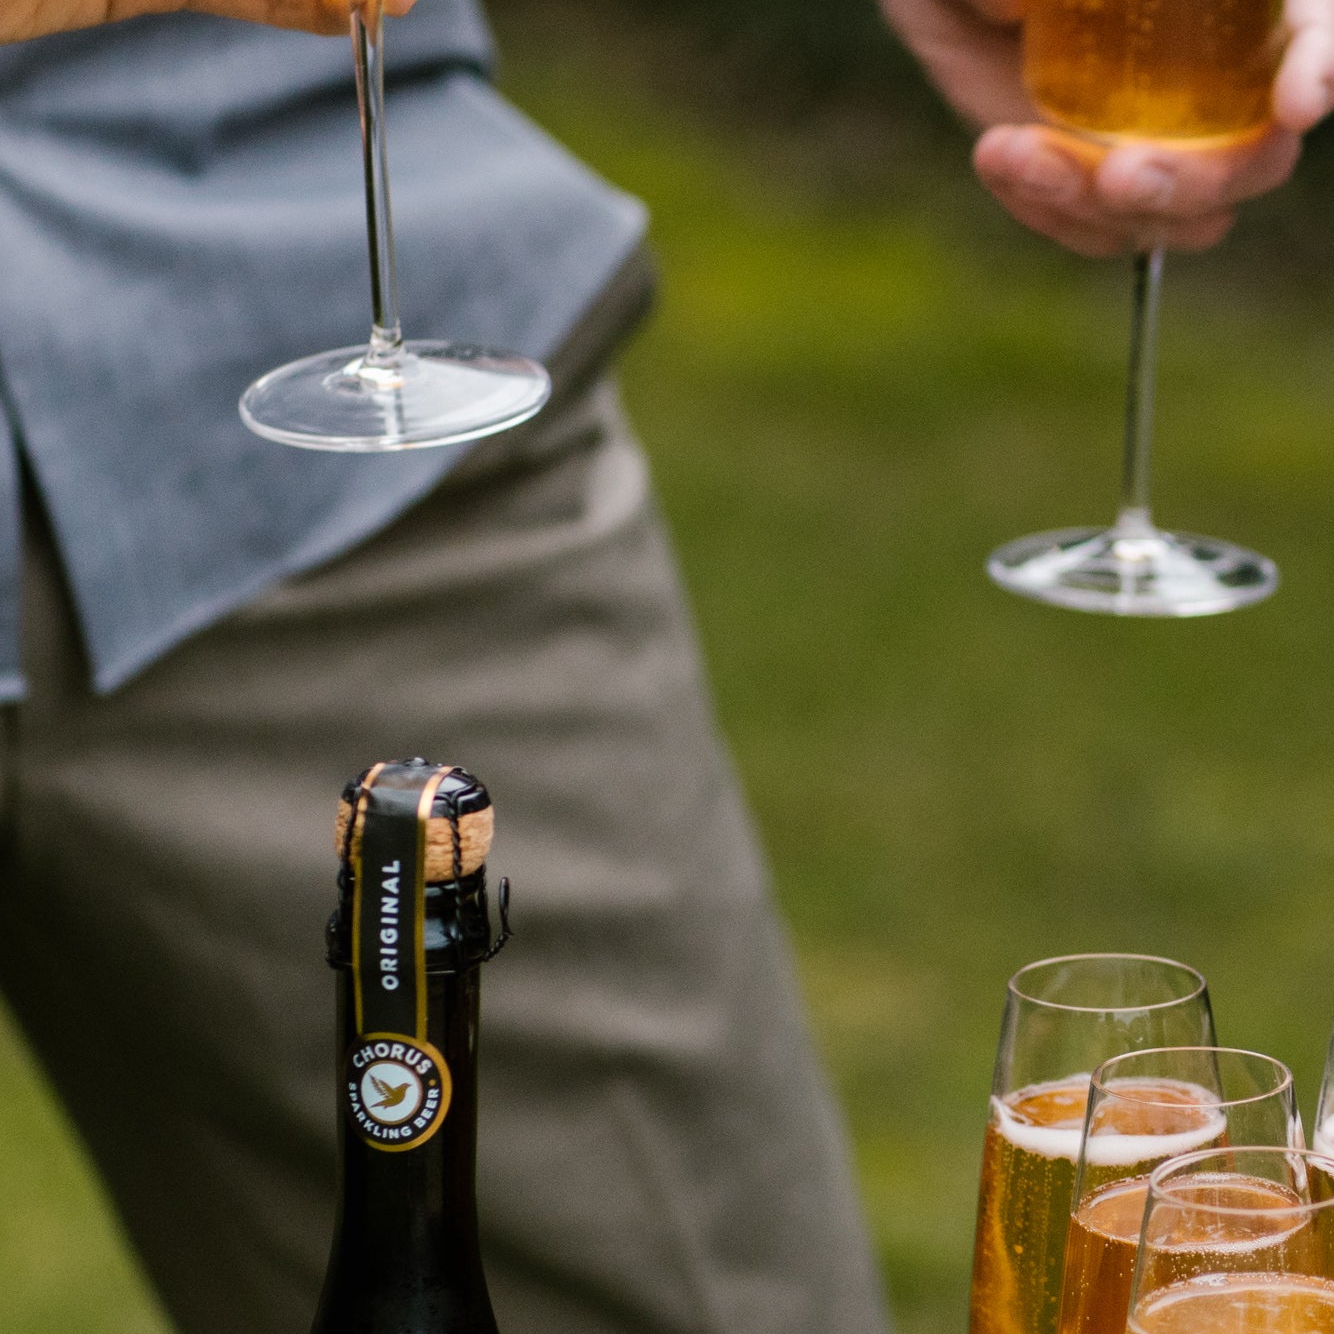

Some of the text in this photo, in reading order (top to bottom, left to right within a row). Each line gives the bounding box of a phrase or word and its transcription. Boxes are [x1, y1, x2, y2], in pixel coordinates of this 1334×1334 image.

[379, 859, 401, 991] ORIGINAL
[352, 1042, 433, 1075] CHORUS
[348, 1082, 440, 1139] SPARKLING BEER
